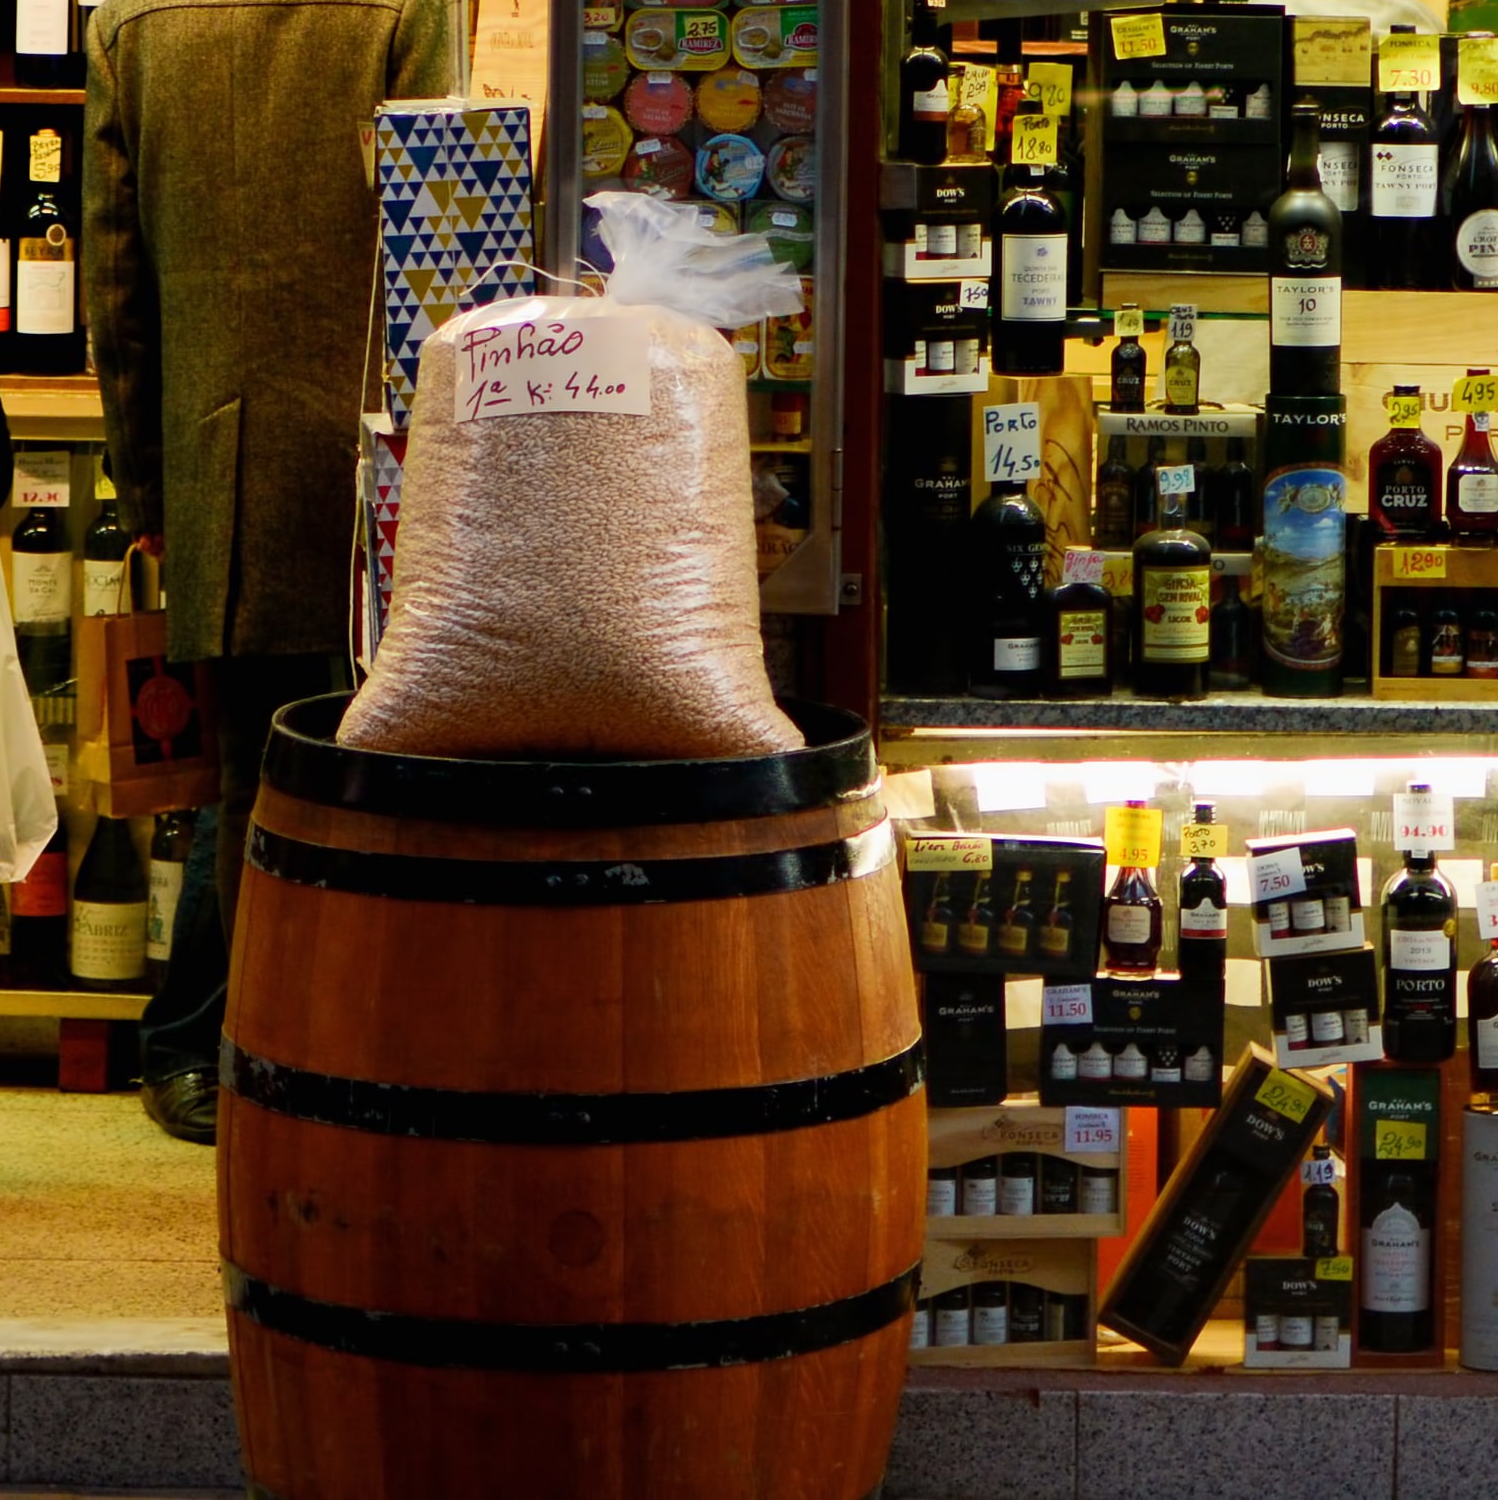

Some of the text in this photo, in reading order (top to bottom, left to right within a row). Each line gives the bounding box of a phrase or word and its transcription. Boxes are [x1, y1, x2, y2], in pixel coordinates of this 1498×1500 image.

[1170, 25, 1218, 35] GRAHAM'S
[679, 37, 723, 51] RAMIREZ
[1120, 36, 1158, 53] 11.50
[1390, 70, 1432, 86] 7.30
[1169, 154, 1217, 164] GRAHAM'S
[1381, 164, 1434, 174] FONSECA
[936, 187, 965, 198] DOW'S
[1276, 285, 1335, 294] TAYLOR'S
[461, 323, 584, 383] Pinhão
[1127, 417, 1229, 433] RAMOS PINTO
[1273, 412, 1347, 426] TAYLOR'S
[1385, 485, 1426, 494] PORTO
[21, 492, 62, 504] 12.90
[1381, 494, 1429, 508] CRUZ
[1119, 848, 1149, 862] 4.95
[1260, 874, 1291, 891] 7.50
[1307, 976, 1343, 990] DOW'S
[1396, 979, 1445, 991] PORTO
[1112, 989, 1160, 999] GRAHAM'S
[938, 1005, 994, 1015] GRAHAM'S
[1047, 1002, 1087, 1018] 11.50
[1368, 1100, 1433, 1112] GRAHAM'S
[1074, 1129, 1115, 1145] 11.95
[1371, 1239, 1422, 1249] GRAHAM'S
[1282, 1279, 1318, 1291] DOW'S
